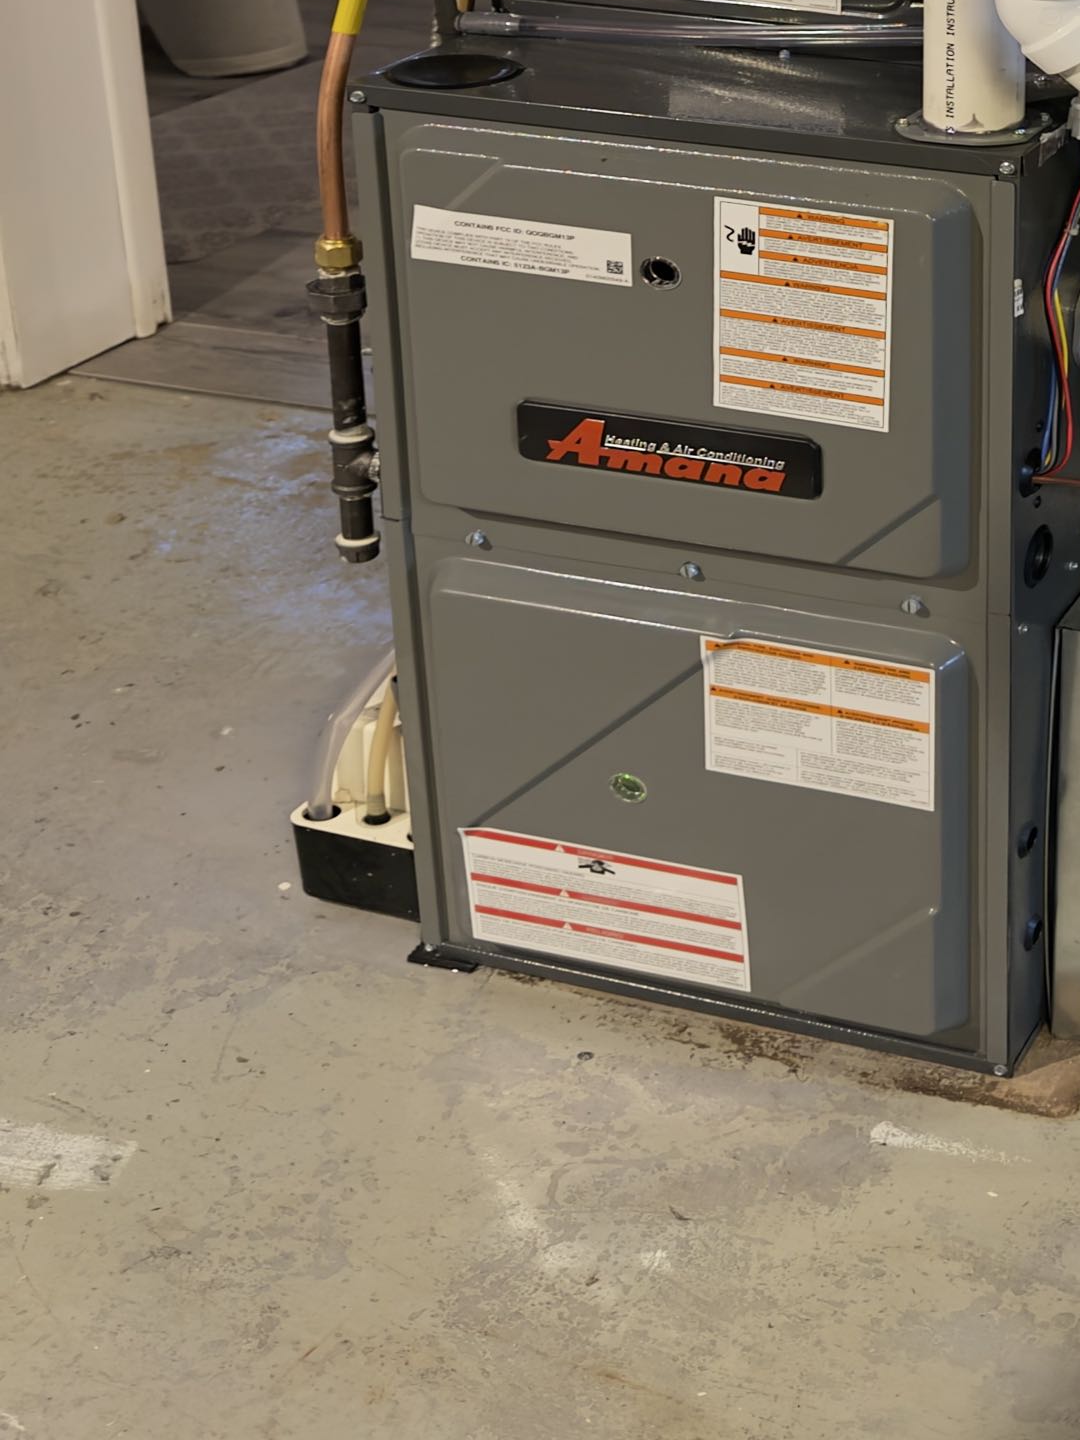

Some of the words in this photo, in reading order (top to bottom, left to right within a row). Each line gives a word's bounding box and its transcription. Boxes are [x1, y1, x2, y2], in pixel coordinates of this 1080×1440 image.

[946, 43, 955, 118] INSTALLATION
[454, 220, 494, 231] CONTAINS
[496, 225, 512, 234] FCC
[461, 255, 500, 266] CONTAINS
[546, 418, 787, 492] Amana
[604, 434, 657, 452] Heating
[659, 441, 670, 452] &
[673, 444, 693, 456] Air
[696, 447, 786, 471] Conditioning
